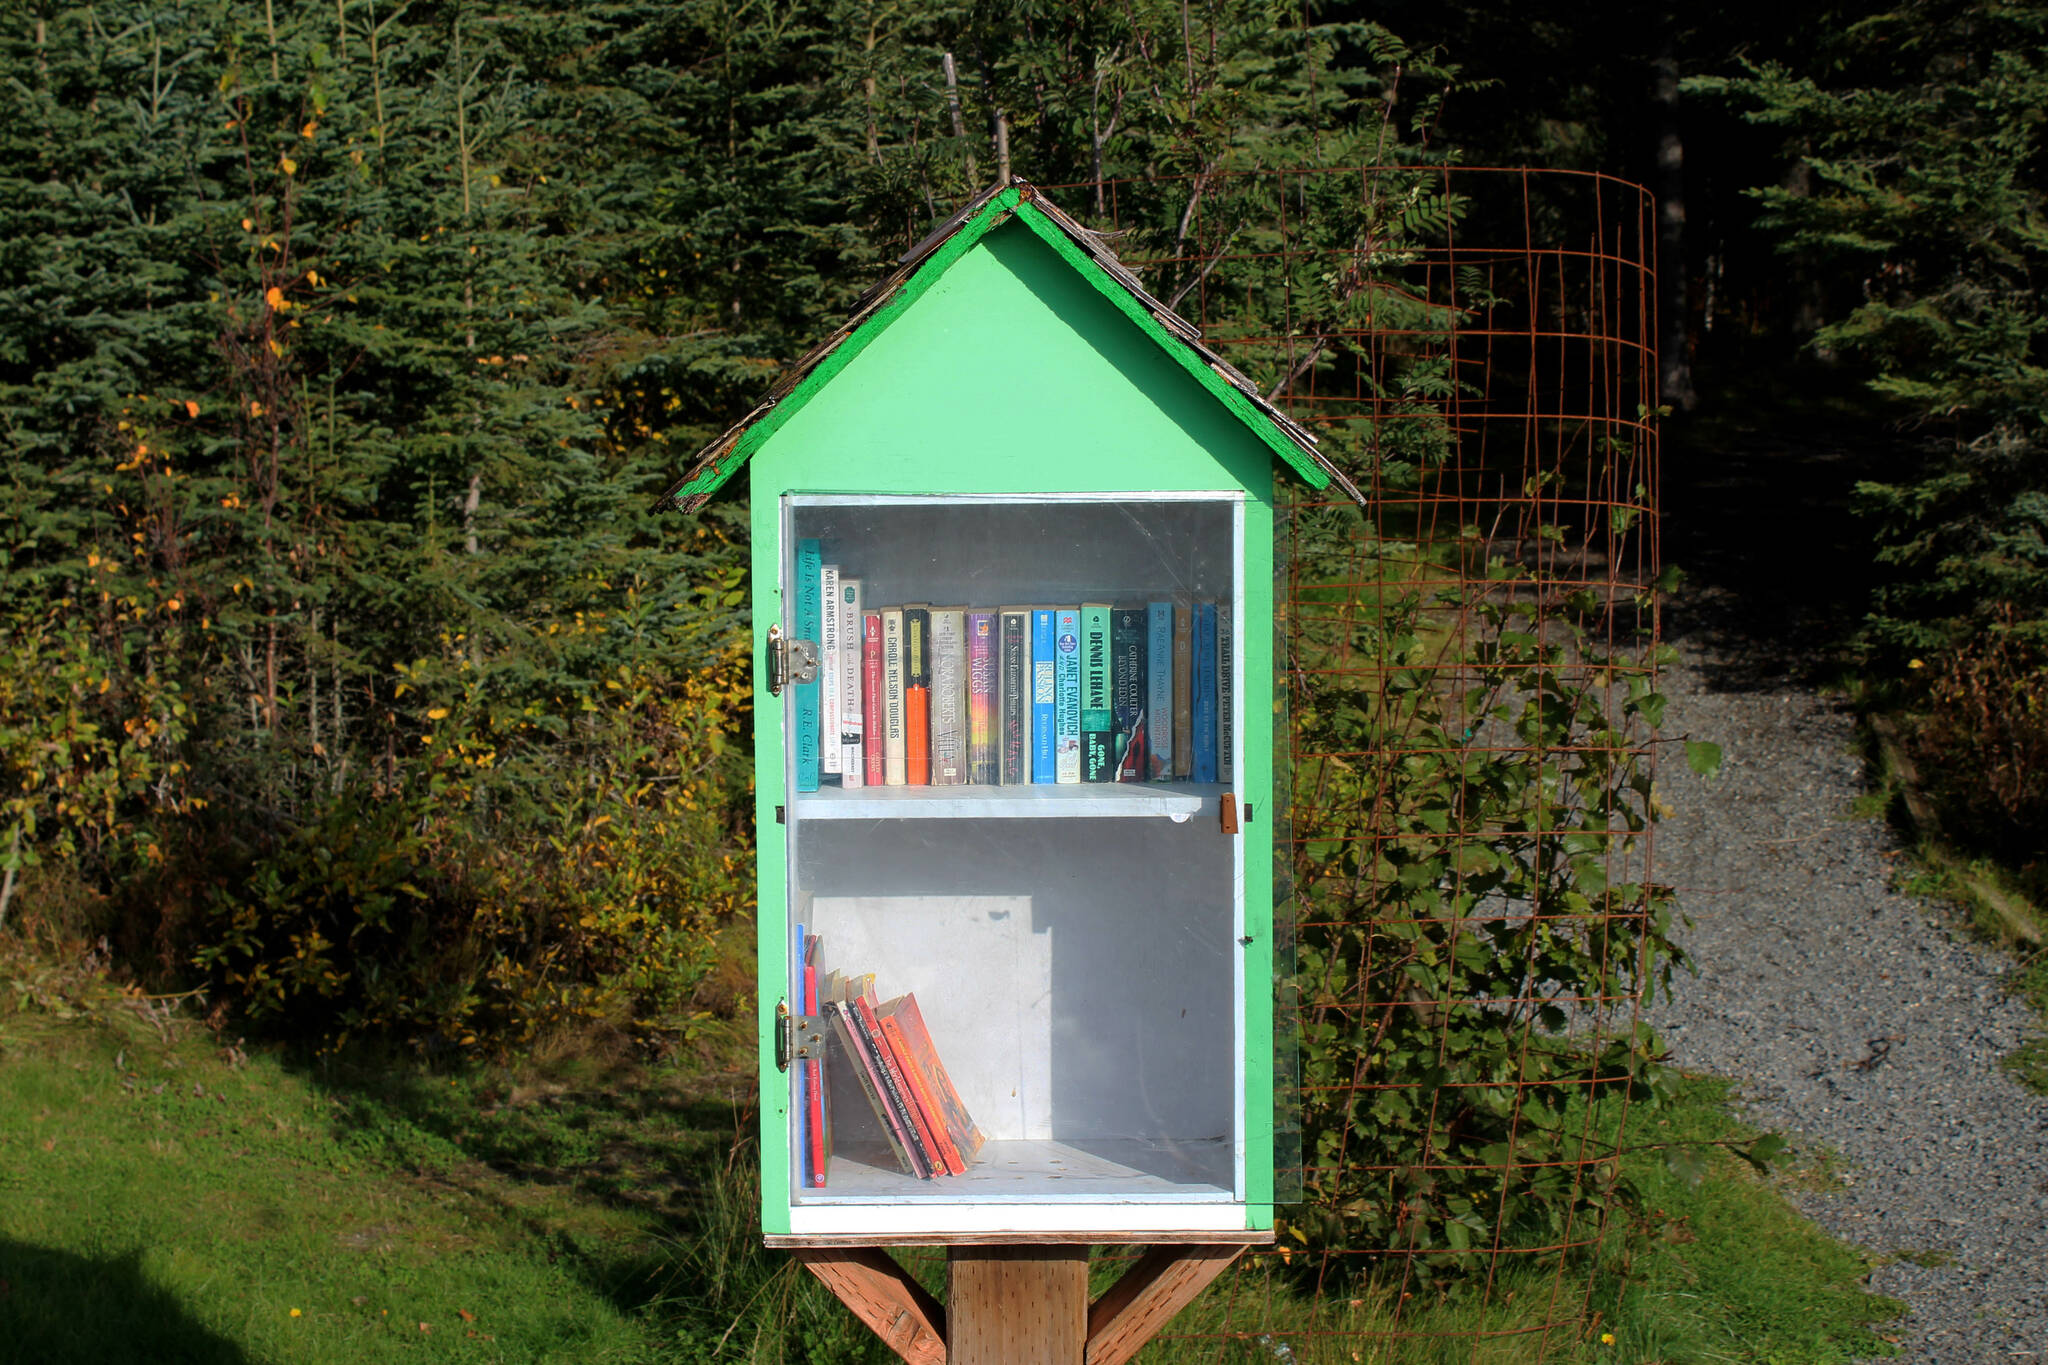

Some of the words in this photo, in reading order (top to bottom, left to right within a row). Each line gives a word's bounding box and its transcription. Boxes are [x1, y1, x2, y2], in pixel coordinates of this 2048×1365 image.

[802, 550, 815, 570] Life
[805, 574, 814, 583] Is
[825, 570, 835, 597] KAREN
[804, 586, 815, 605] Not
[804, 606, 813, 616] A
[826, 599, 836, 651] ARMSTRONG
[846, 612, 854, 650] BRUSH
[888, 637, 898, 667] CAROLE
[1090, 631, 1103, 668] DENNIS
[1156, 626, 1166, 667] RAEANNE
[1221, 637, 1231, 665] TRAIL
[940, 653, 955, 682] NORA
[972, 657, 983, 694] WIGGS
[983, 656, 995, 693] SUSAN
[1066, 655, 1078, 683] JANET
[1118, 655, 1127, 686] BEYOND
[1128, 645, 1138, 683] CATHERINE
[1221, 665, 1231, 693] DRIVE
[847, 667, 855, 706] DEATH
[888, 668, 898, 700] NELSON
[1036, 663, 1045, 703] PASSION
[1044, 663, 1053, 702] RULING
[1058, 673, 1066, 706] Charlotte
[1090, 670, 1103, 710] LEHANE
[1119, 687, 1128, 707] EDEN
[1157, 671, 1166, 702] THAYNE
[941, 683, 956, 724] ROBERTS
[1066, 686, 1078, 736] EVANOVICH
[1129, 684, 1138, 716] COULTER
[1222, 695, 1231, 722] PETER
[801, 708, 813, 730] R.E.
[889, 702, 900, 739] DOUGLAS
[1057, 708, 1066, 736] Hughes
[1161, 707, 1169, 750] WOODROSE
[802, 734, 813, 764] Clark
[1041, 745, 1049, 760] HILL
[1088, 733, 1097, 757] BABY,
[1097, 744, 1105, 769] GONE,
[1089, 758, 1097, 782] GONE
[885, 1056, 893, 1067] The
[889, 1066, 900, 1083] World
